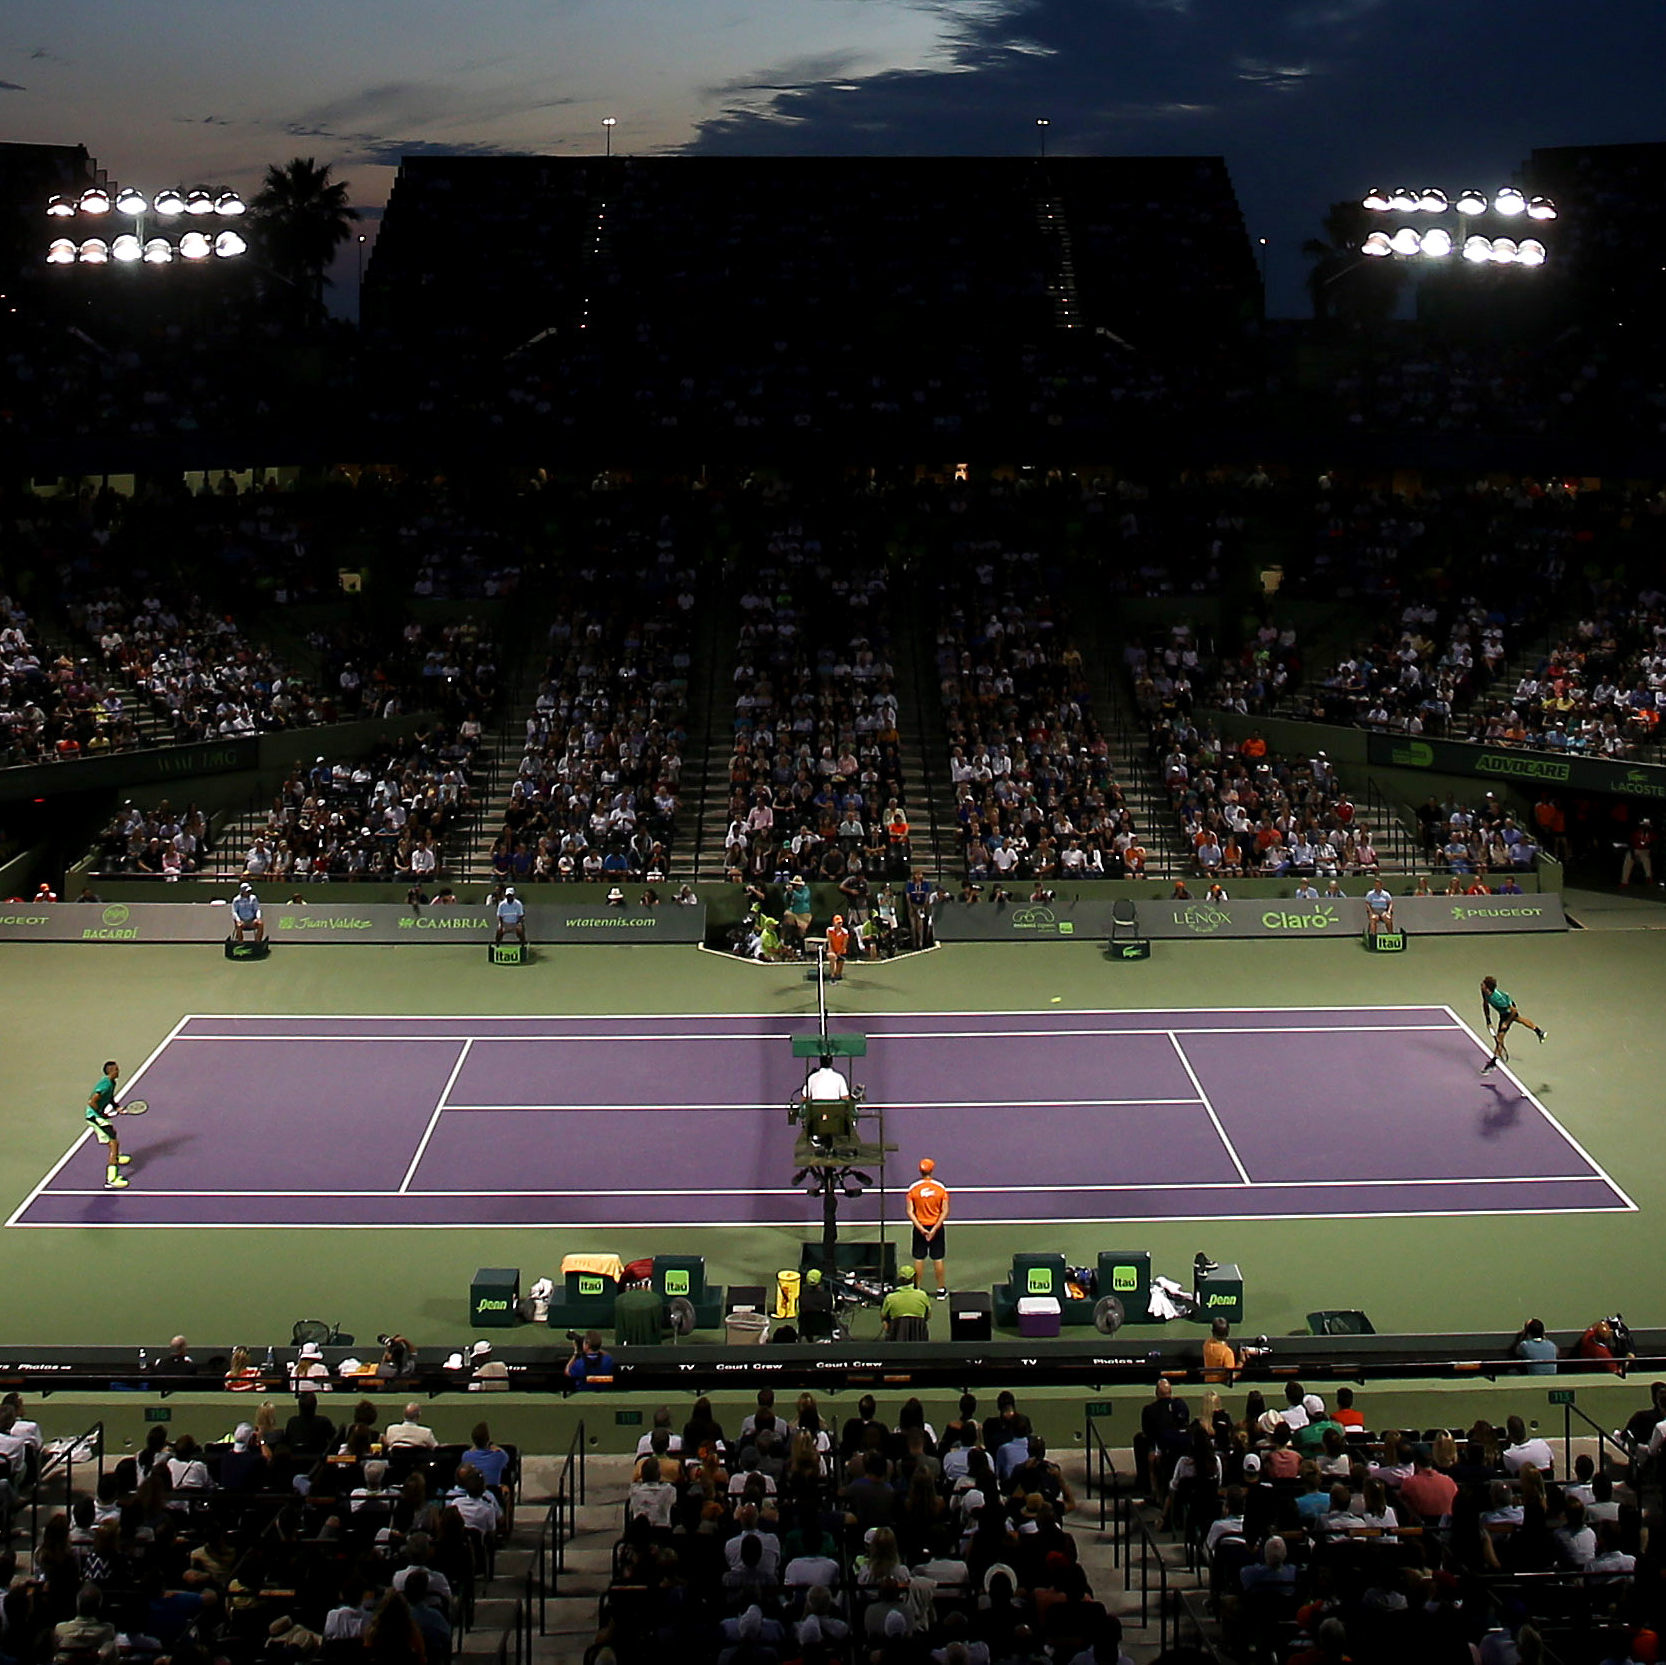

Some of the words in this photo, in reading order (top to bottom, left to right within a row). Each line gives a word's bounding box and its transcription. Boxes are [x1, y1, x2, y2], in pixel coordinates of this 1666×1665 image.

[1480, 755, 1570, 780] ADVOCARE
[1611, 782, 1666, 796] LACOSTE
[1173, 911, 1232, 925] LENOX
[1468, 907, 1543, 917] PEUGEOT
[416, 917, 490, 929] CAMBRIA
[566, 916, 656, 928] wtatennis.com
[1262, 909, 1332, 929] Claro
[1379, 937, 1401, 950] Itaú
[495, 948, 520, 962] Itaú
[581, 1276, 602, 1291] Itaú
[667, 1279, 688, 1292] Itaú
[1029, 1278, 1050, 1290] Itaú
[1114, 1276, 1136, 1288] Itaú
[816, 1361, 849, 1369] Court
